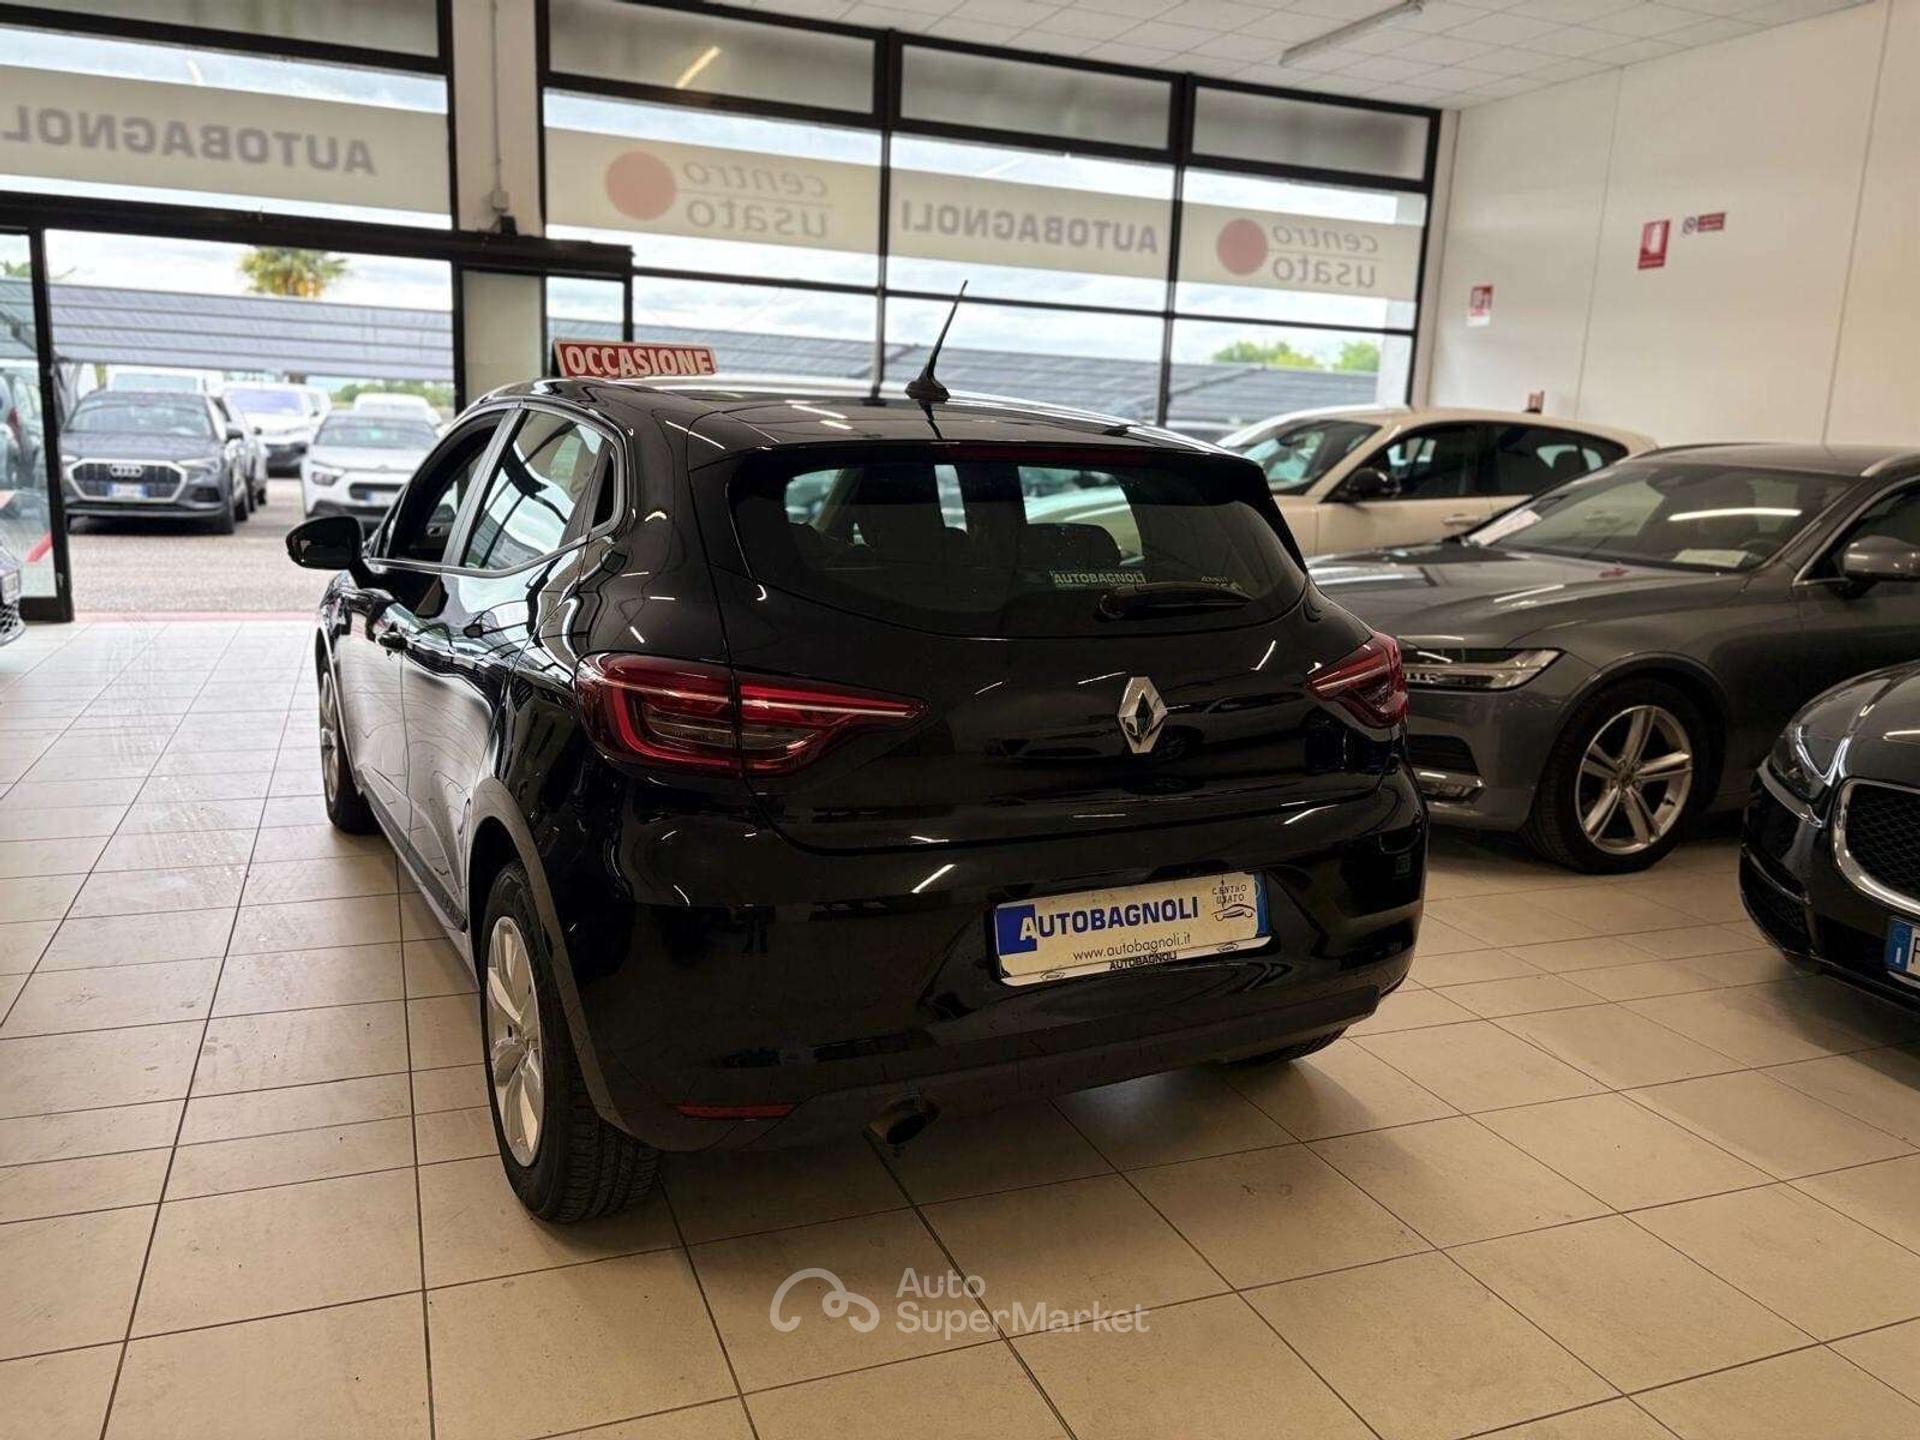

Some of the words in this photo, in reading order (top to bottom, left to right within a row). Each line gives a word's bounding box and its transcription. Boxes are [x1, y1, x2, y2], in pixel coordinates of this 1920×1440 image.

[564, 345, 714, 376] OCCASIONE
[1053, 572, 1147, 585] AUTOBAGNOLI
[1018, 896, 1199, 942] AUTOBAGNOLI
[1072, 933, 1192, 962] www.autobagnoli.it
[1109, 951, 1178, 972] AUTOBAGNOLI
